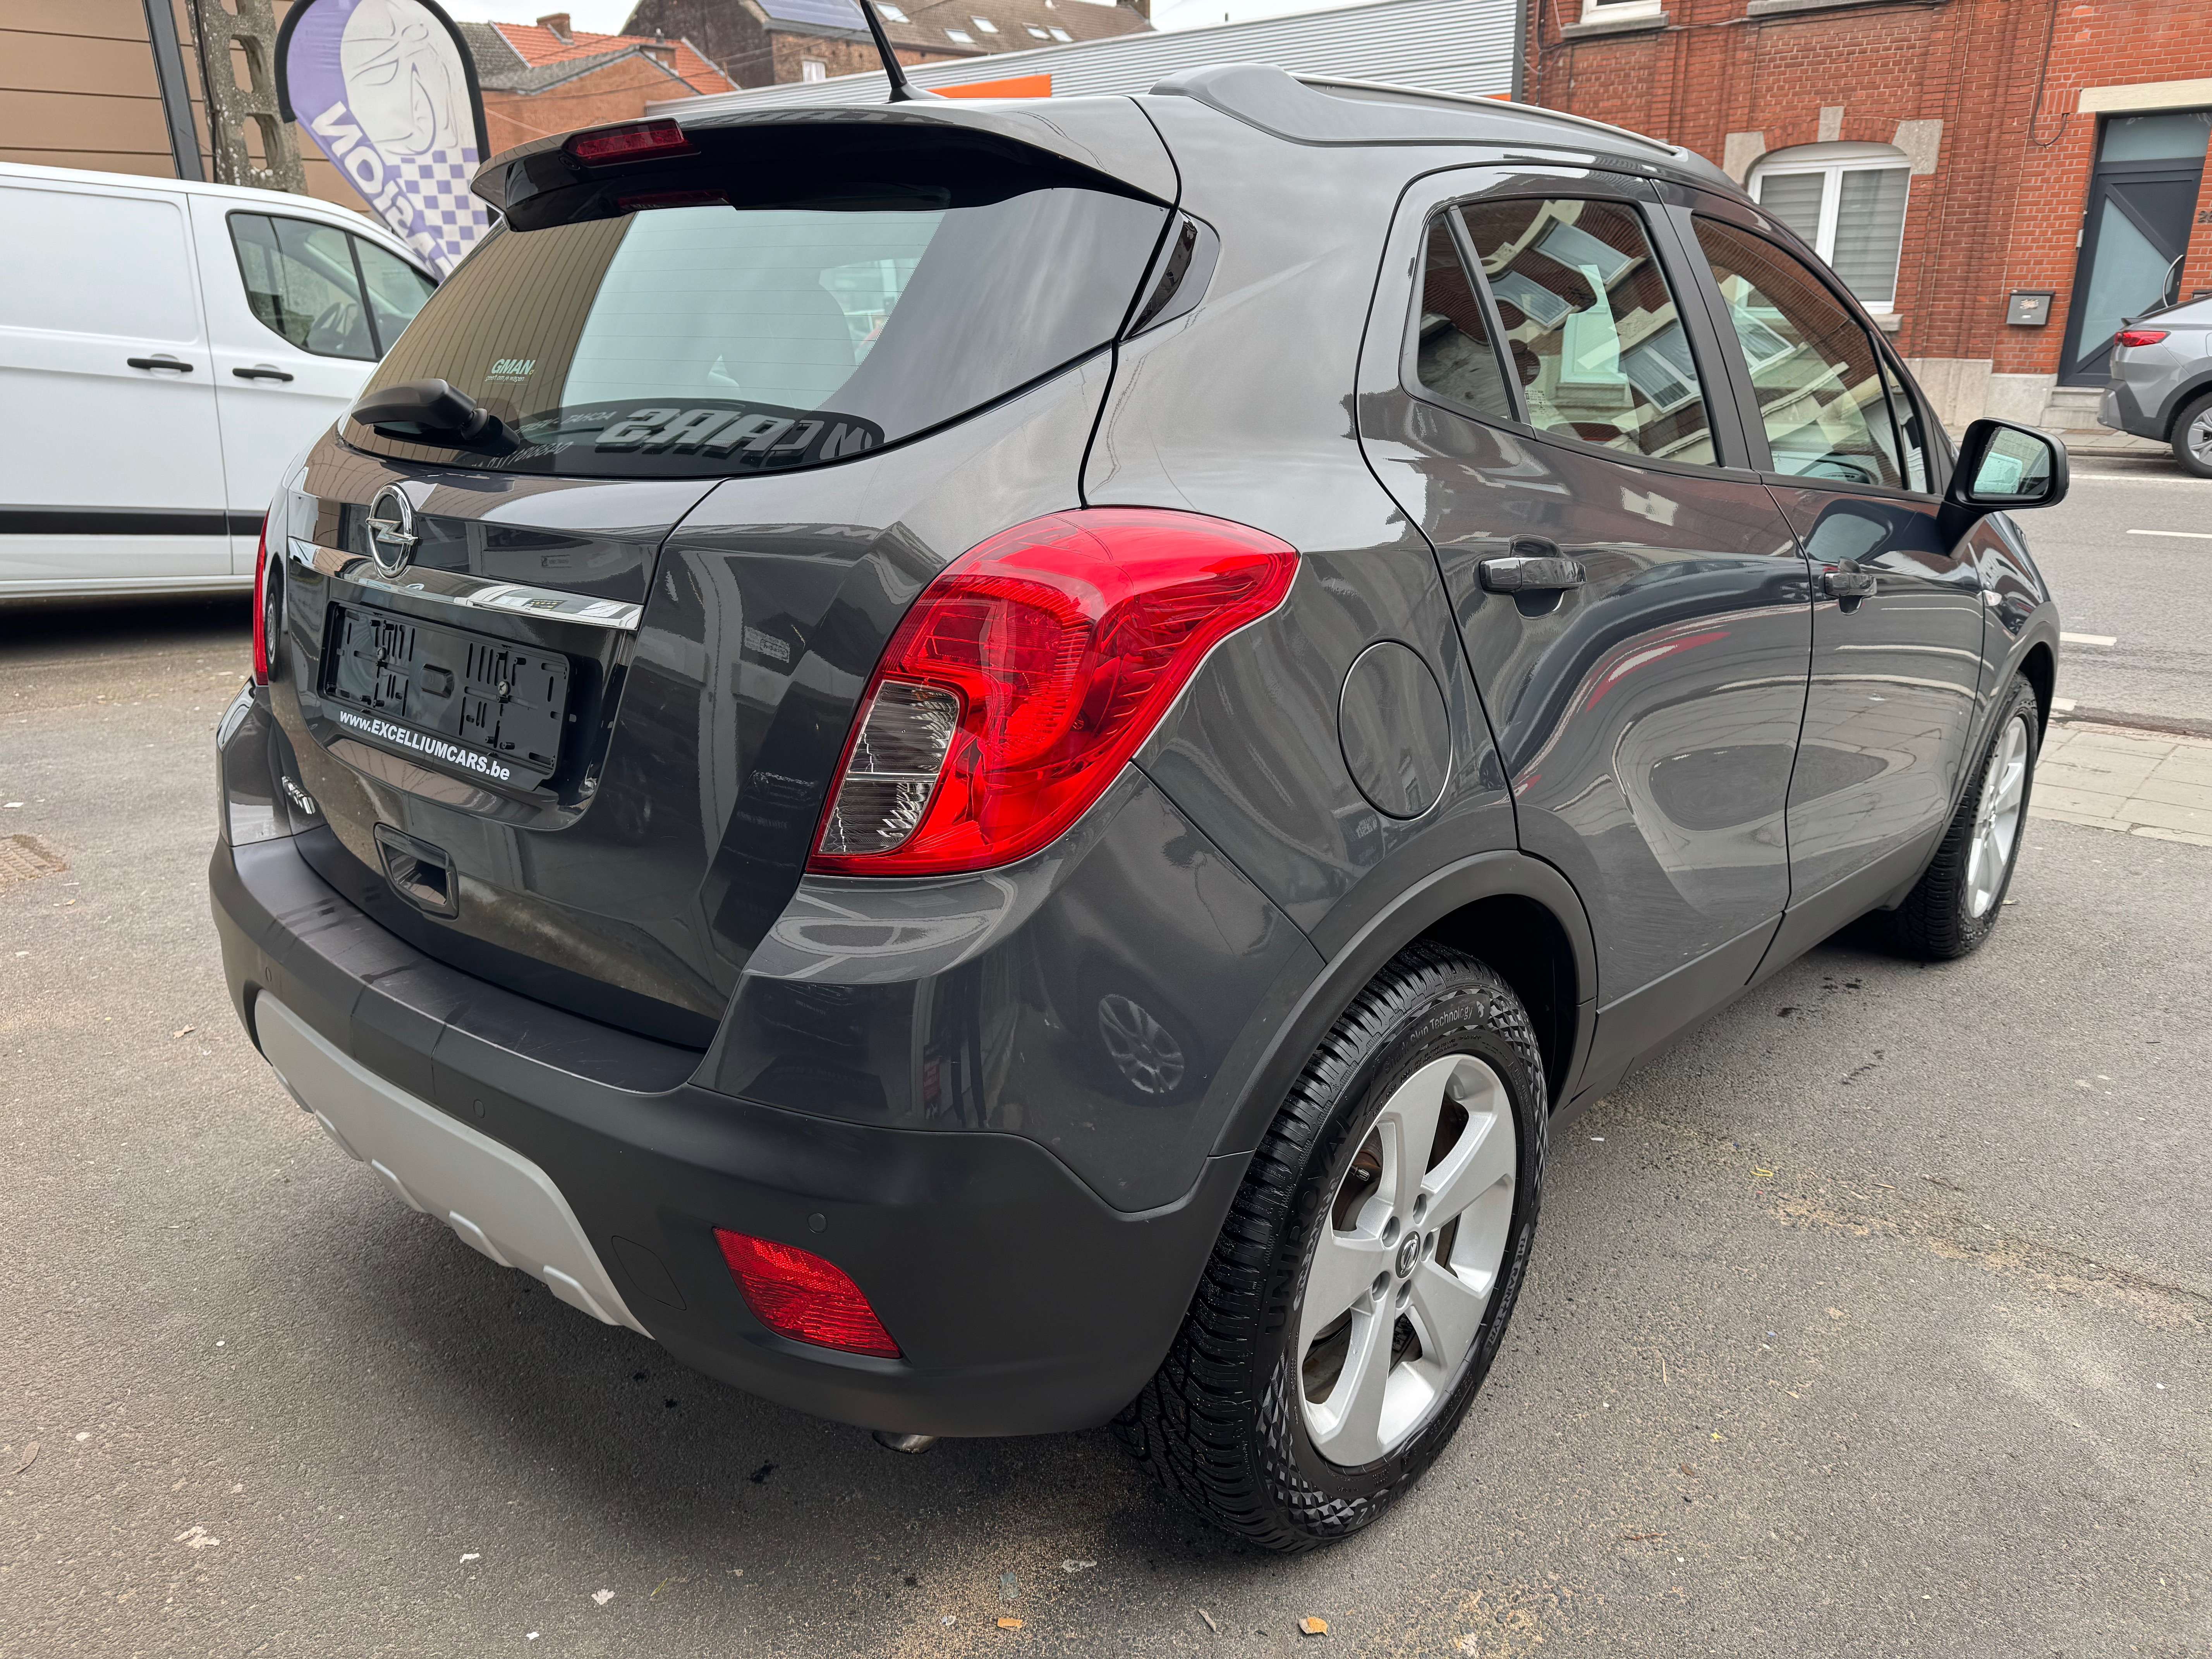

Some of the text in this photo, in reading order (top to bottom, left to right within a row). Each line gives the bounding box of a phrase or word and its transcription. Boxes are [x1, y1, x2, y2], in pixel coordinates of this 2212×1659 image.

[491, 359, 536, 374] GMAN
[340, 711, 510, 780] www.EXCELLIUMCARS.be
[1410, 1025, 1429, 1044] Skin
[1429, 1005, 1473, 1030] Technology
[1265, 1114, 1359, 1334] UNIROYAL
[1515, 1236, 1529, 1262] THE
[1503, 1267, 1518, 1305] RAIN
[1485, 1316, 1504, 1350] TYRE
